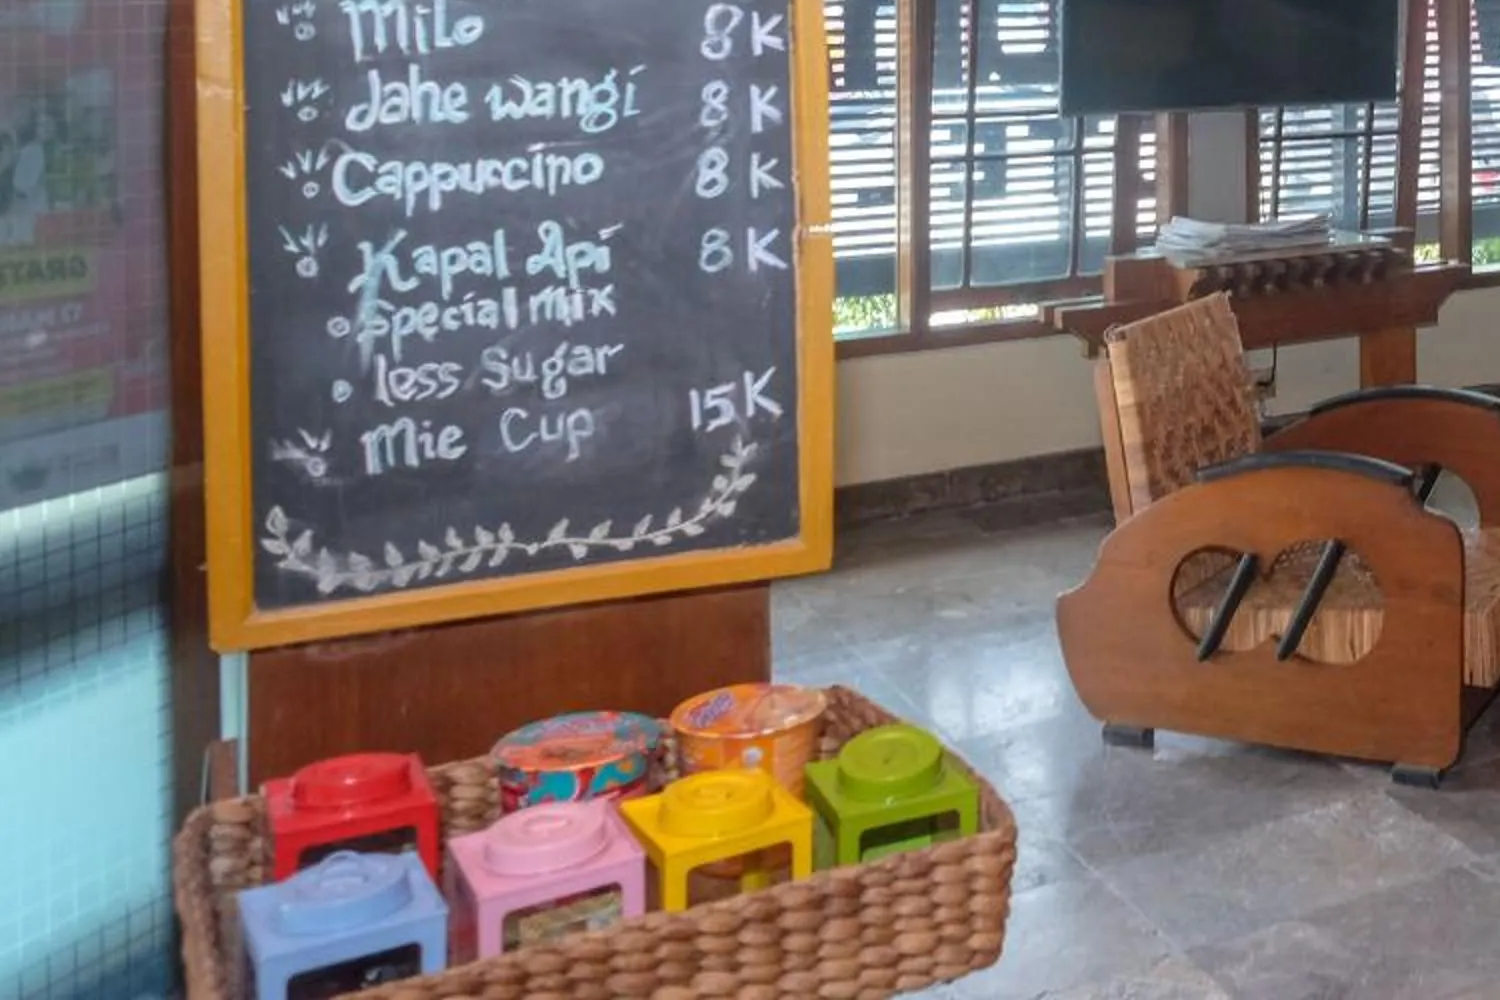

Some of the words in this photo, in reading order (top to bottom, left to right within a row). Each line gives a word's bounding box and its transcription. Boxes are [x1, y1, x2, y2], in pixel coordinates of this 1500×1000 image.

[331, 150, 605, 217] Cappuccino
[348, 230, 511, 295] Kapal
[525, 219, 624, 287] Api
[360, 417, 468, 475] Mie
[501, 406, 598, 462] Cup
